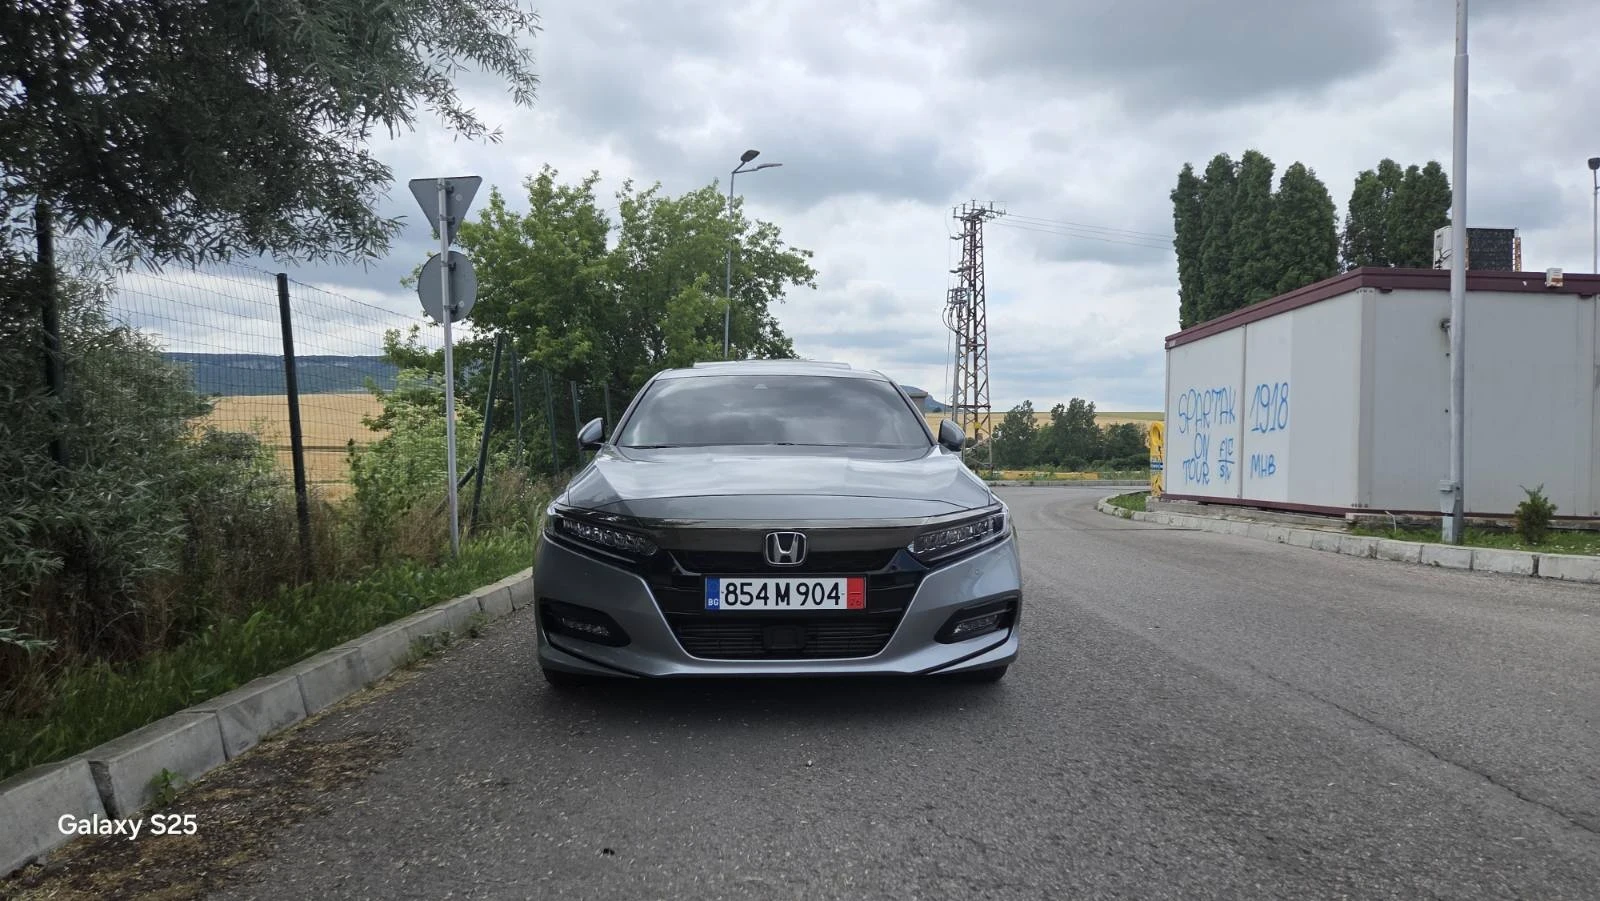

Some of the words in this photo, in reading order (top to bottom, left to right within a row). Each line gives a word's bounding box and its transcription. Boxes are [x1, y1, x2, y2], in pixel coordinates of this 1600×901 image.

[1178, 385, 1236, 433] SPARTAK
[1249, 382, 1289, 433] 1918
[1194, 432, 1210, 460] ON
[1183, 458, 1210, 485] TOUR
[707, 598, 719, 606] BG
[724, 582, 769, 606] 854
[775, 582, 791, 606] M
[796, 582, 841, 606] 904
